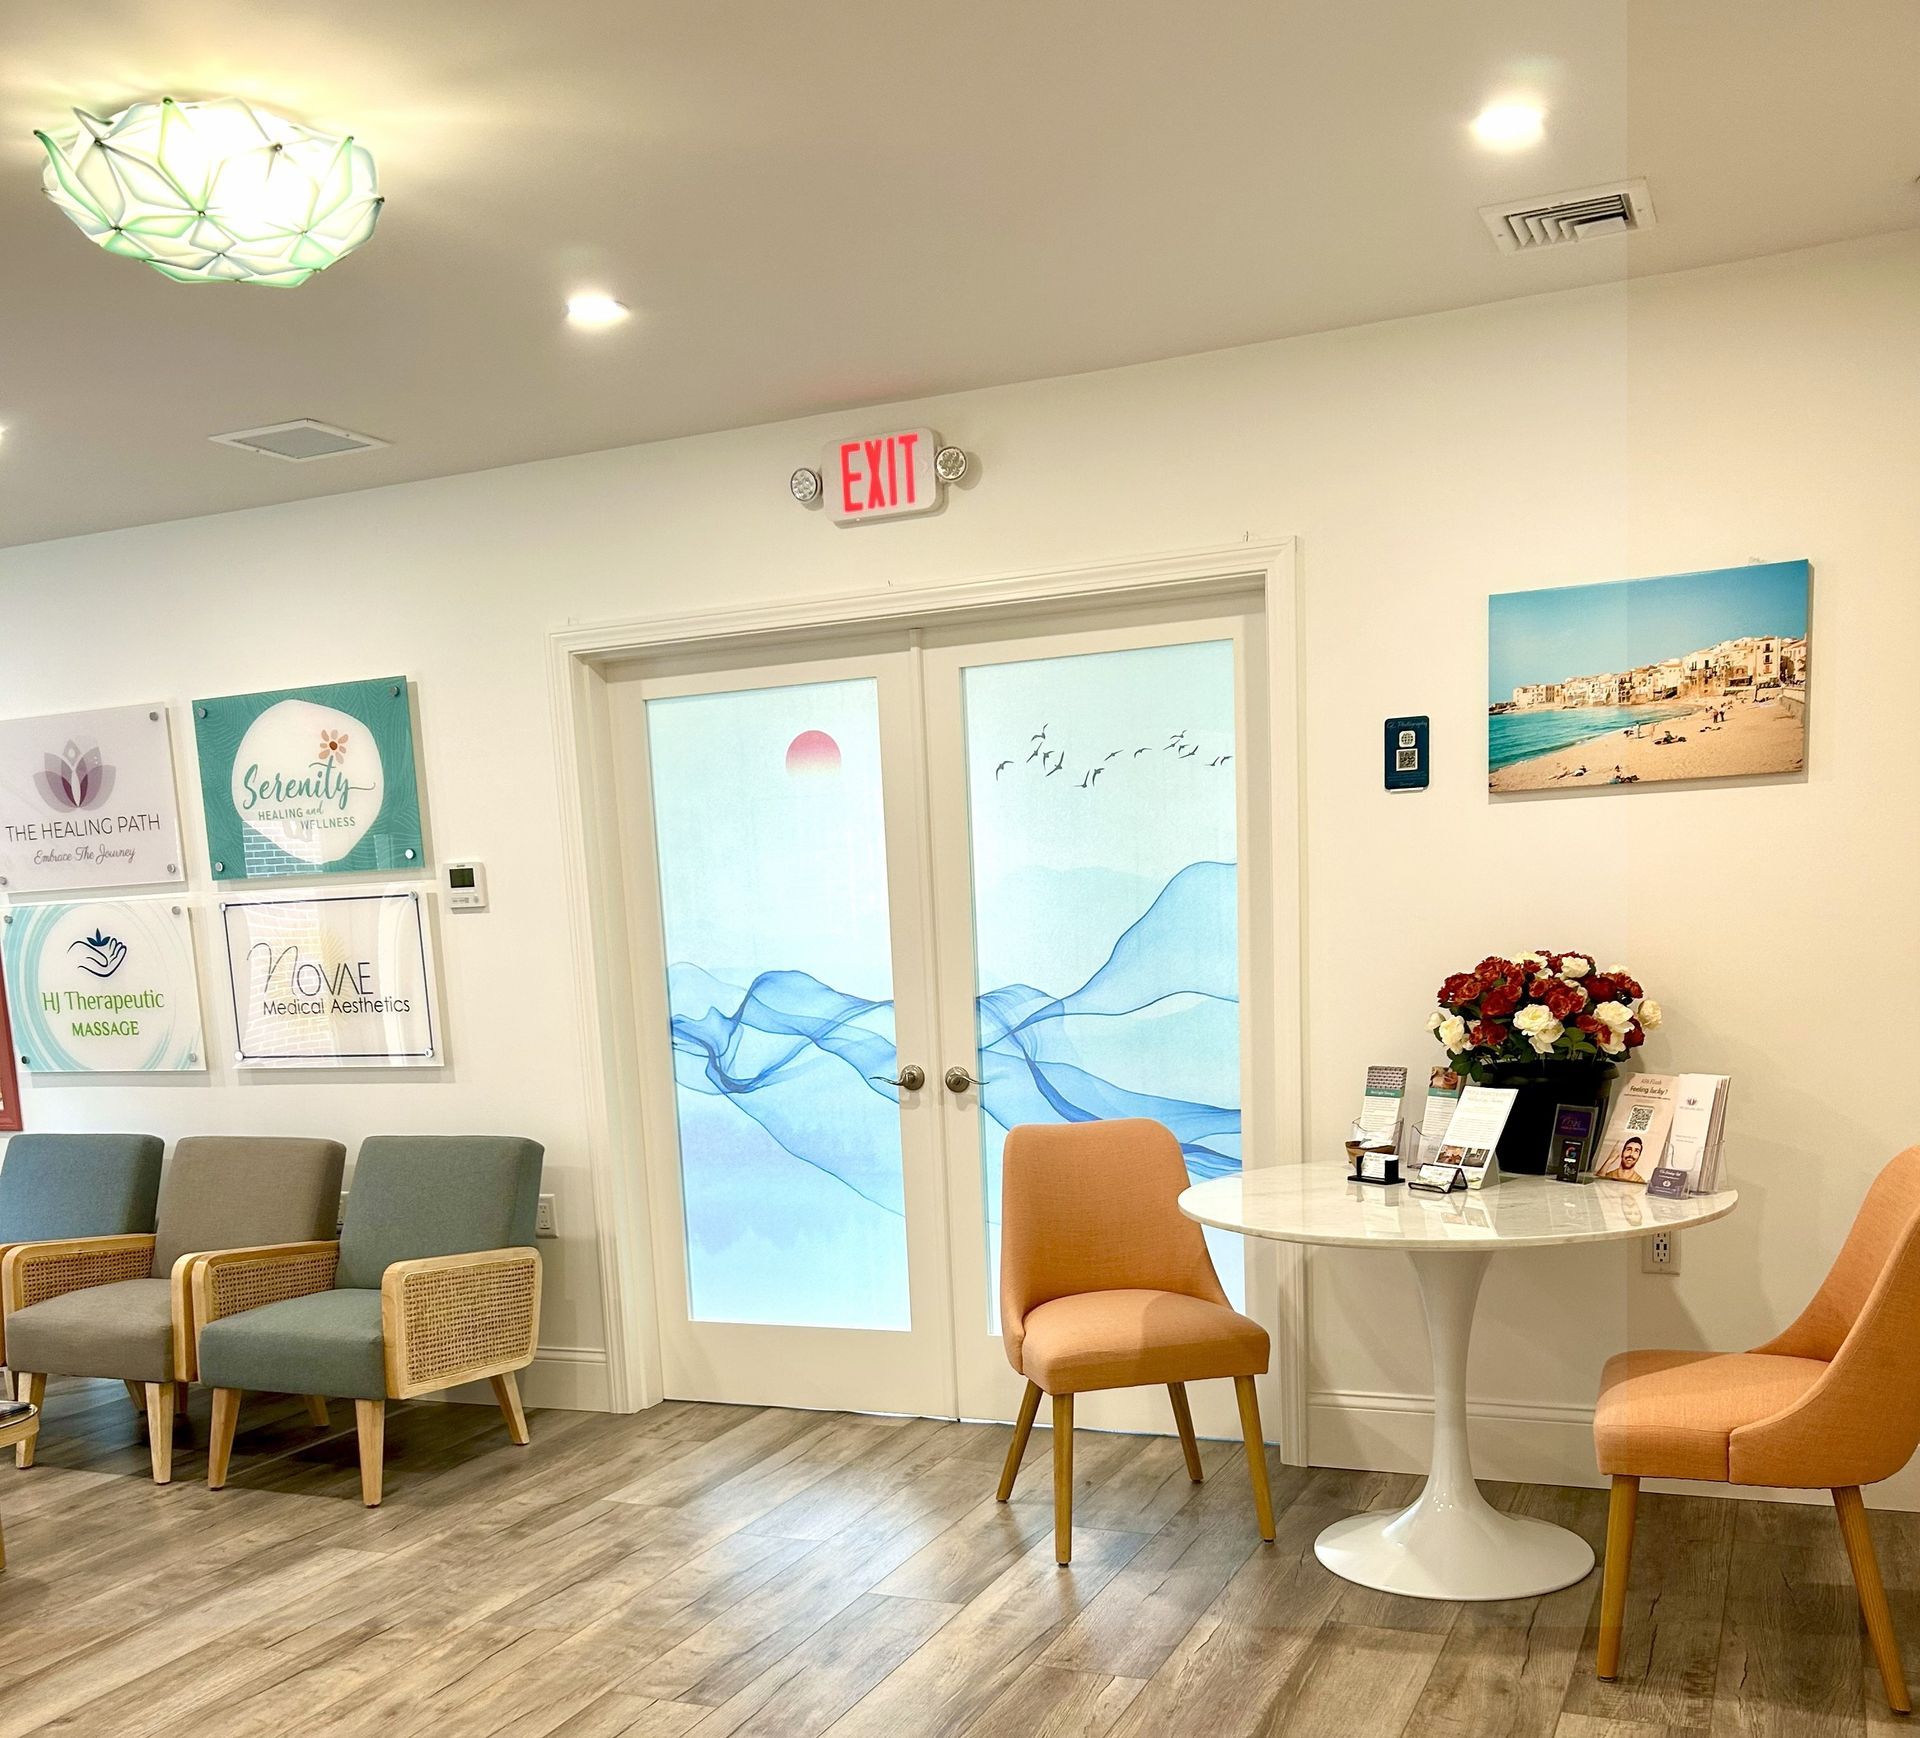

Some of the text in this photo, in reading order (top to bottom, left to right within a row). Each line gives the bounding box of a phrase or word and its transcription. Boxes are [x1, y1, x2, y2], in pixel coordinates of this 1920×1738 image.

[840, 432, 919, 513] EXIT
[242, 754, 376, 810] Serenity
[257, 800, 325, 821] HEALING and
[5, 813, 161, 843] THE HEALING PATH
[299, 816, 356, 830] WELLNESS
[33, 843, 136, 865] Embrace The Journey
[42, 989, 165, 1015] HJ Therapeutic
[262, 996, 411, 1016] Medical Aesthetics
[71, 1020, 140, 1037] MASSAGE
